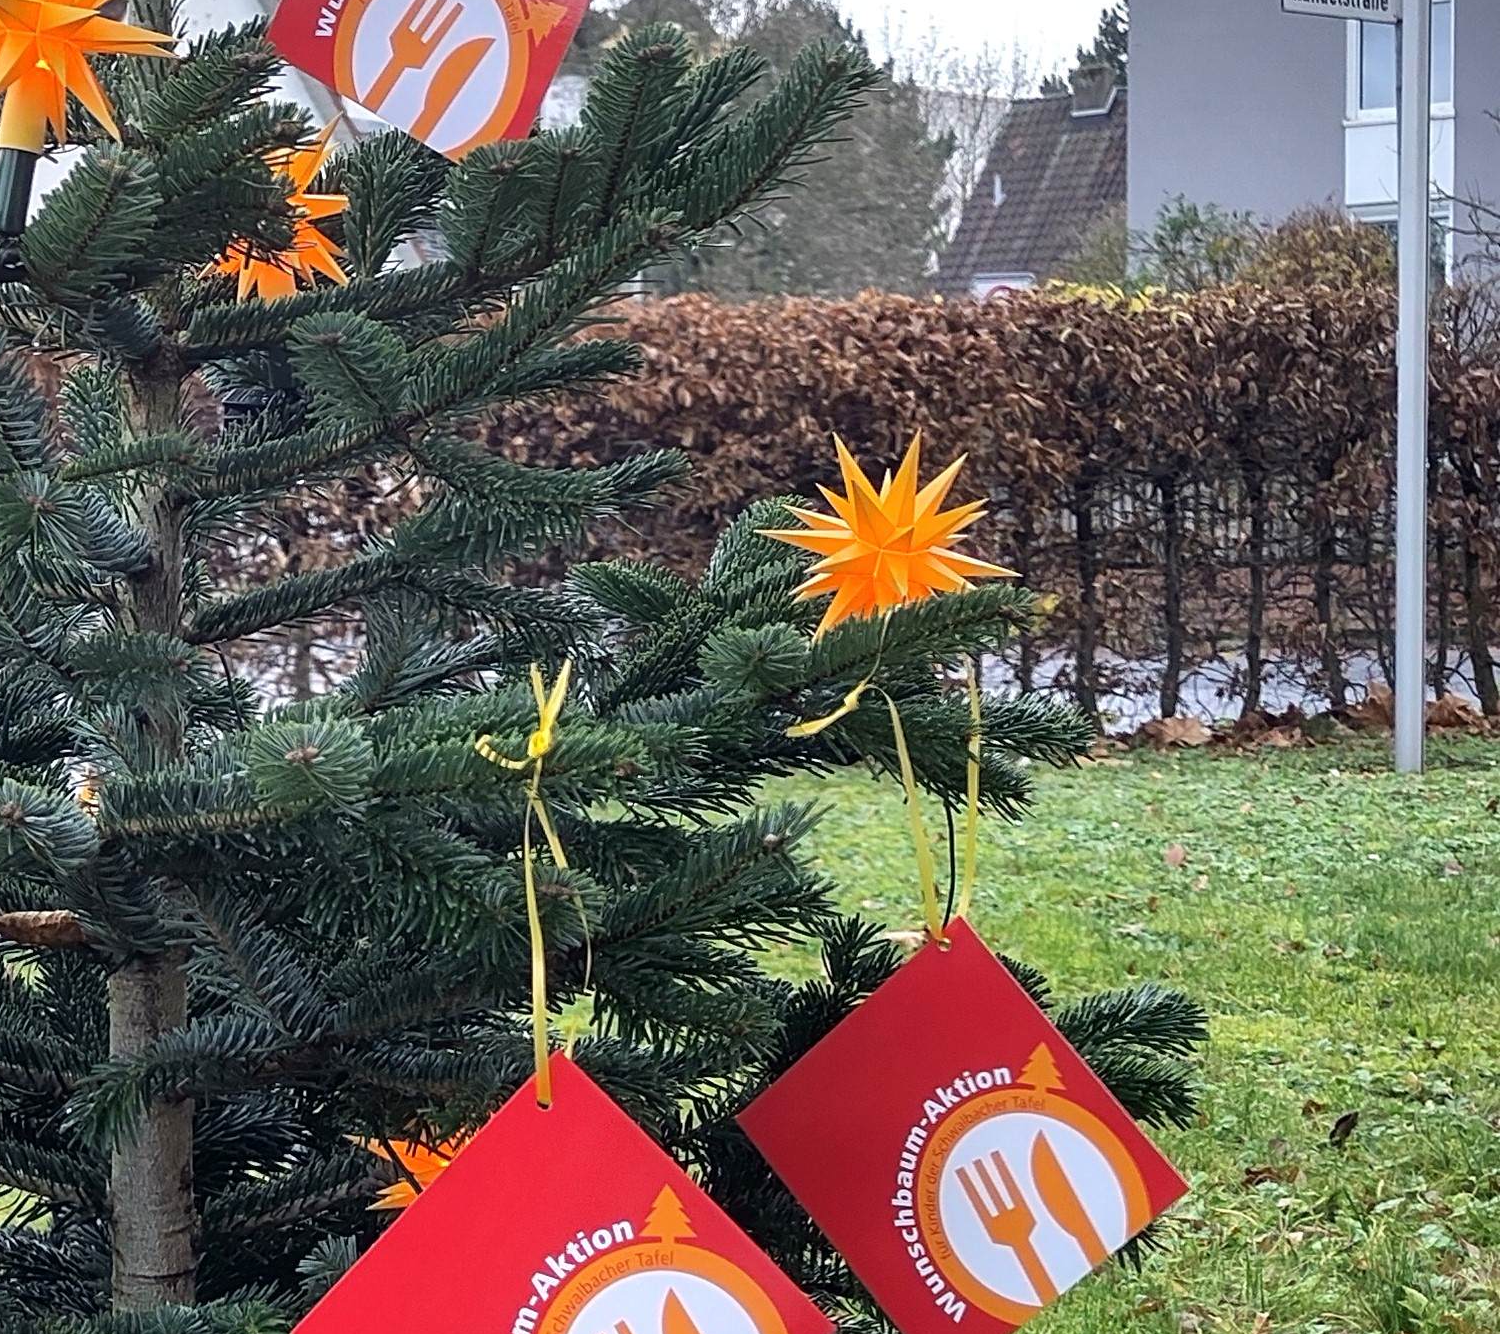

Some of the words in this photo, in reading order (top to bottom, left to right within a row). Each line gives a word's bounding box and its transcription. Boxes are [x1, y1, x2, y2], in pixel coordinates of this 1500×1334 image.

[925, 1162, 940, 1185] der
[891, 1066, 1014, 1324] Wunschbaum-Aktion
[634, 1250, 675, 1268] Tafel
